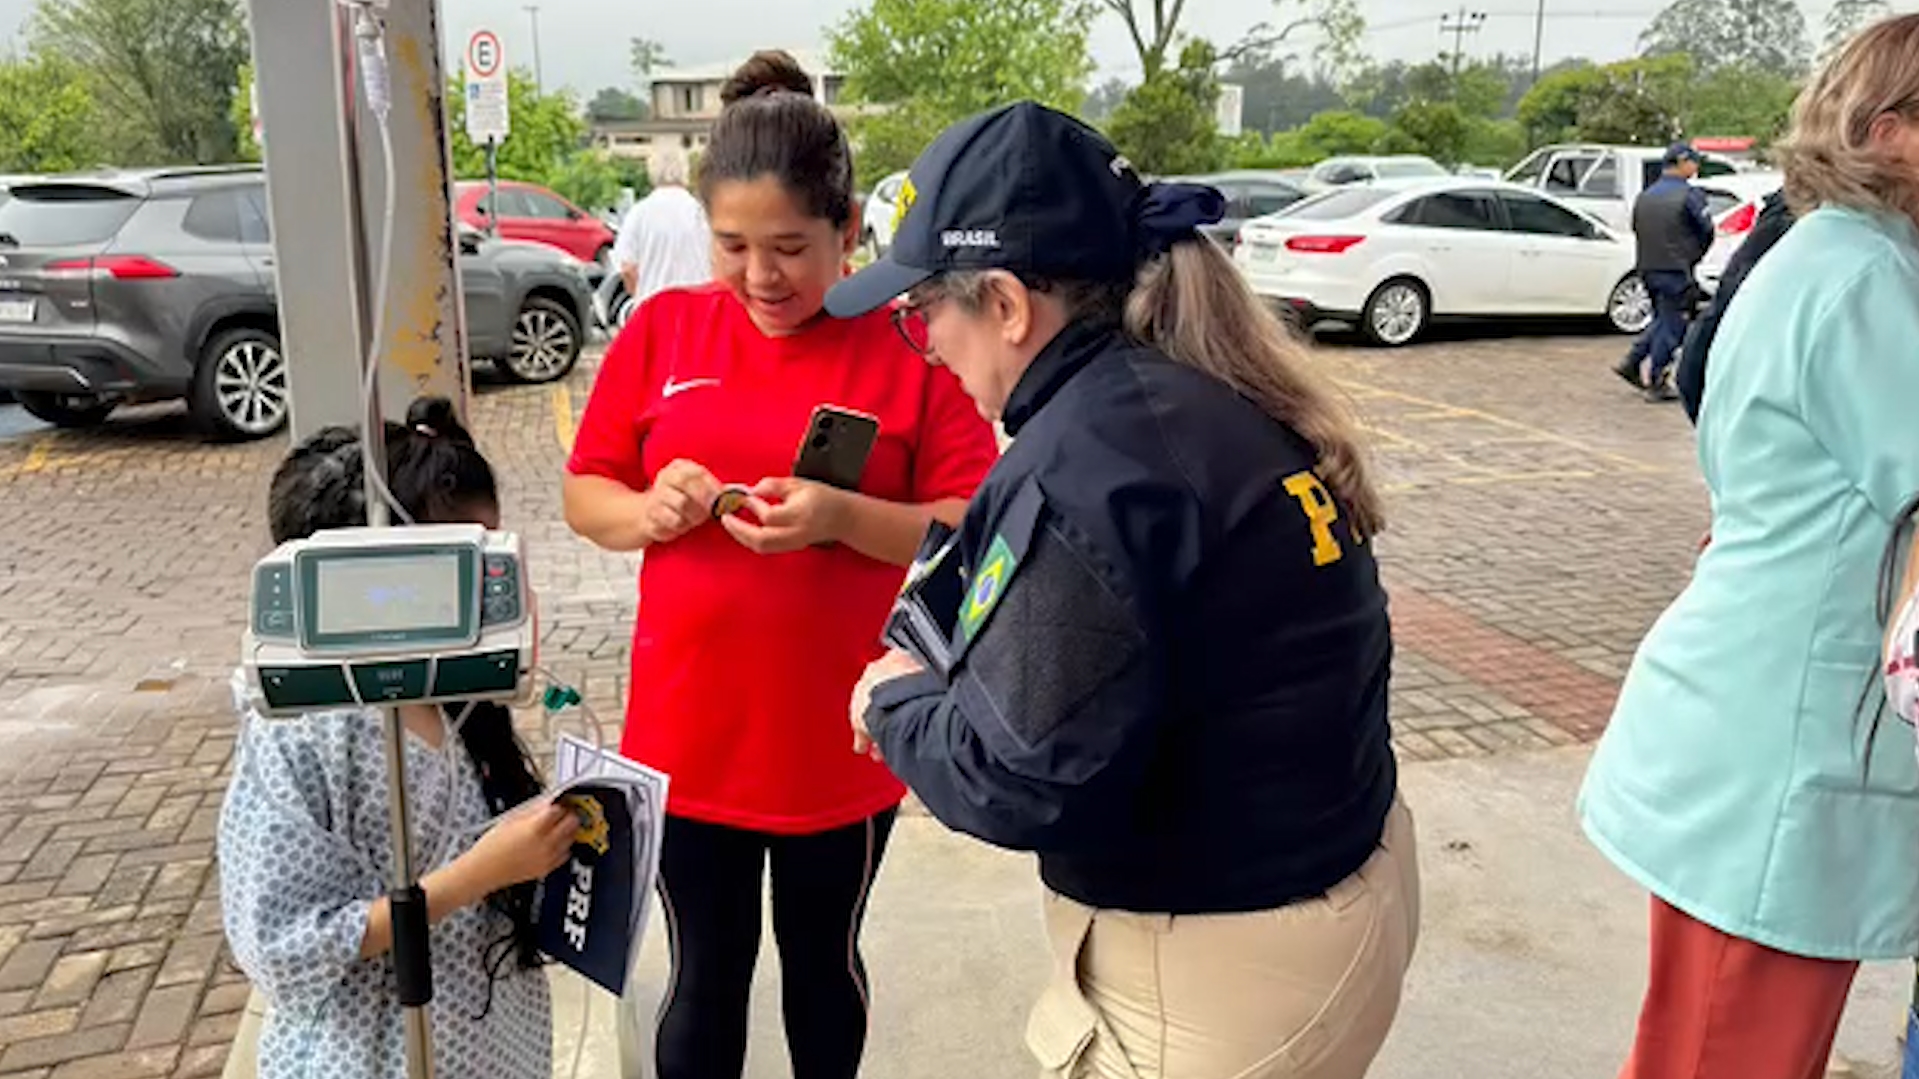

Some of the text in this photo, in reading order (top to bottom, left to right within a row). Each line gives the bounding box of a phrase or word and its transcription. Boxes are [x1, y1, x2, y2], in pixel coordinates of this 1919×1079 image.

[479, 41, 492, 66] E
[941, 230, 1000, 248] BRASIL
[1282, 471, 1362, 566] P
[563, 857, 593, 952] PRF
